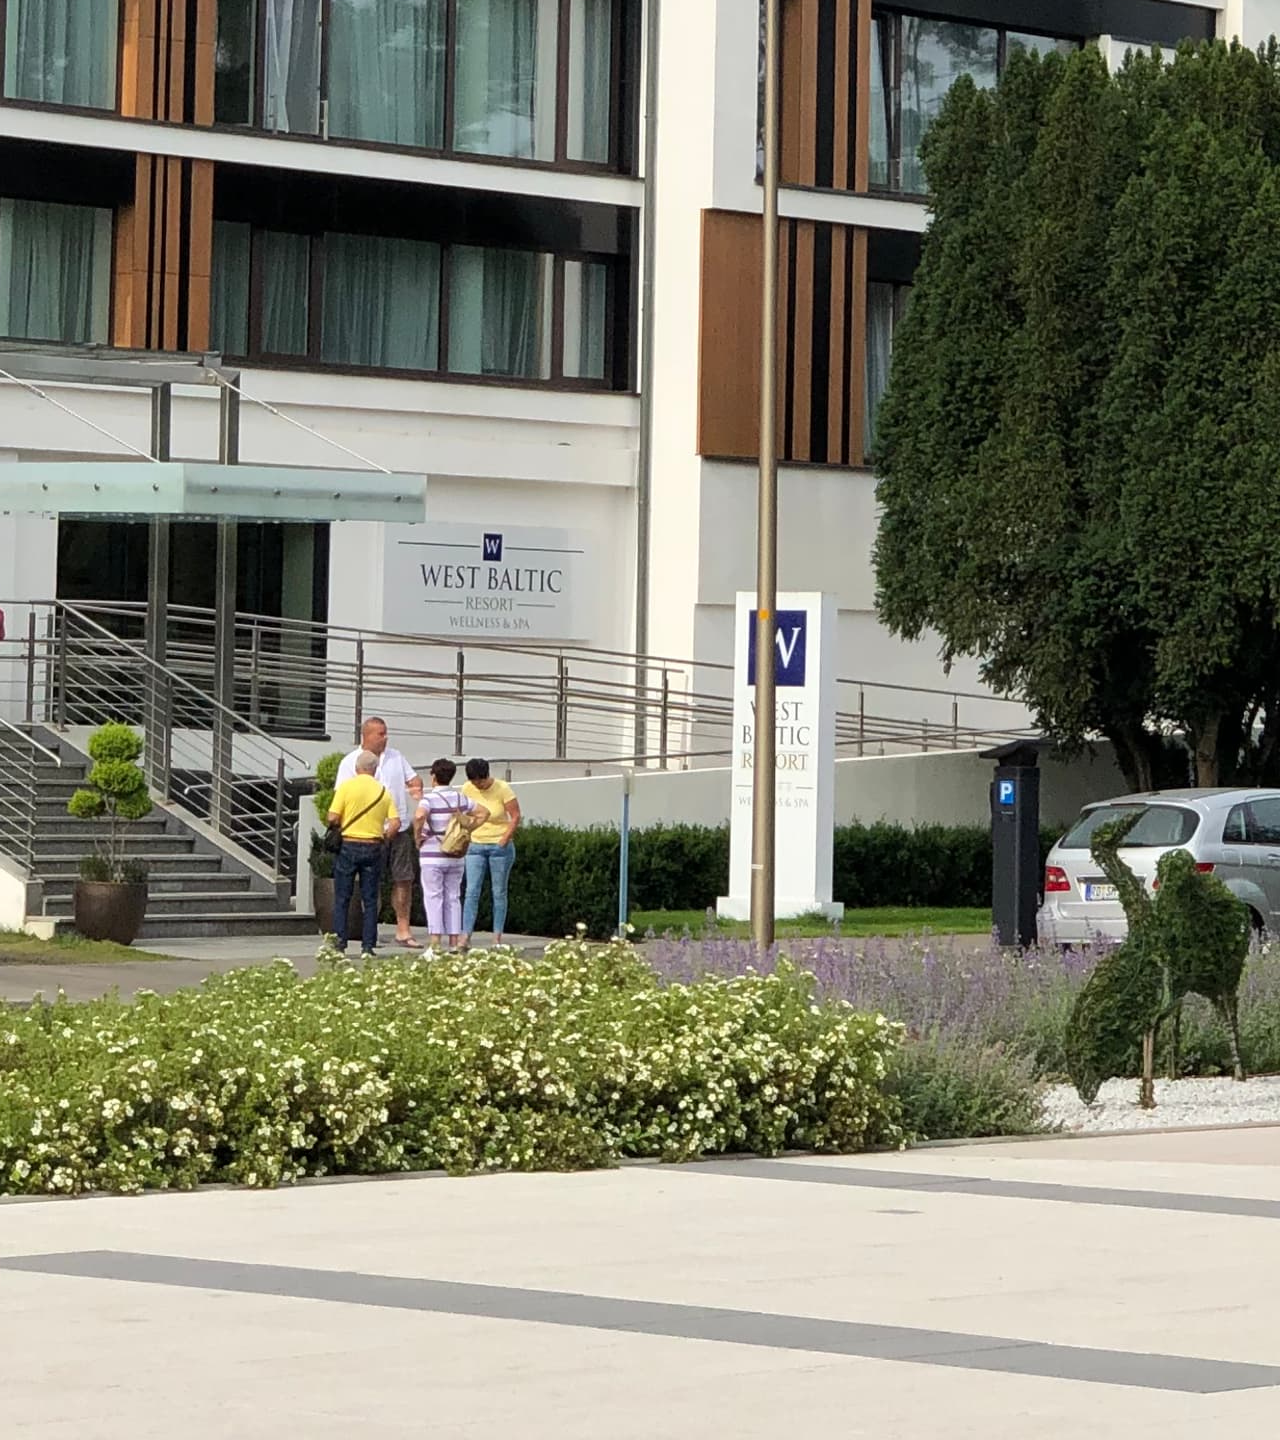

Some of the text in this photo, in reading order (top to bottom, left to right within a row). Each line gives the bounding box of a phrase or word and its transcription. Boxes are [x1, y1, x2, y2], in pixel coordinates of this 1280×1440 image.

[485, 538, 500, 555] W
[420, 563, 562, 593] WEST BALTIC
[465, 596, 515, 611] RESORT
[449, 615, 500, 629] WELLNESS
[513, 618, 530, 630] SPA
[742, 725, 810, 746] BTIC
[742, 752, 808, 771] RORT
[1000, 782, 1012, 800] P
